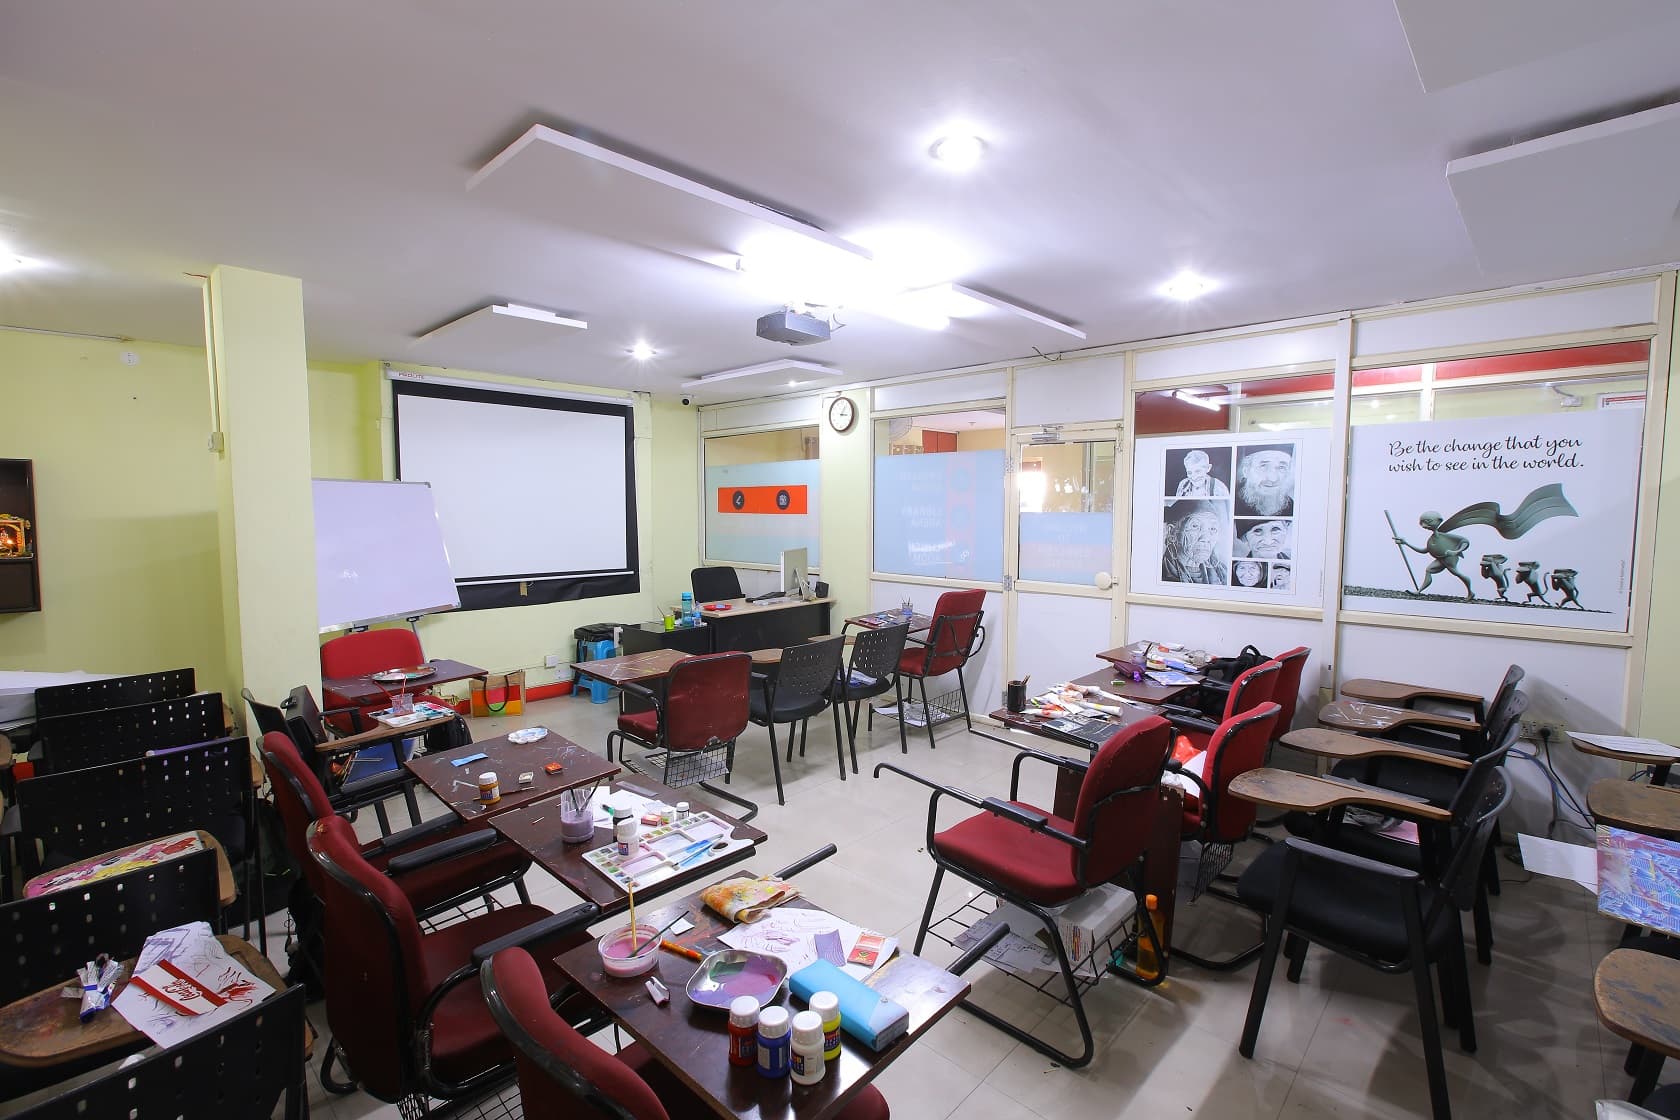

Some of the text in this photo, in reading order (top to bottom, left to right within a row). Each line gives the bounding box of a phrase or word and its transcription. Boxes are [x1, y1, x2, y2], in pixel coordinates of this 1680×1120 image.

[1389, 435, 1583, 458] Be the change that you
[1389, 453, 1584, 472] wish to see in the world.
